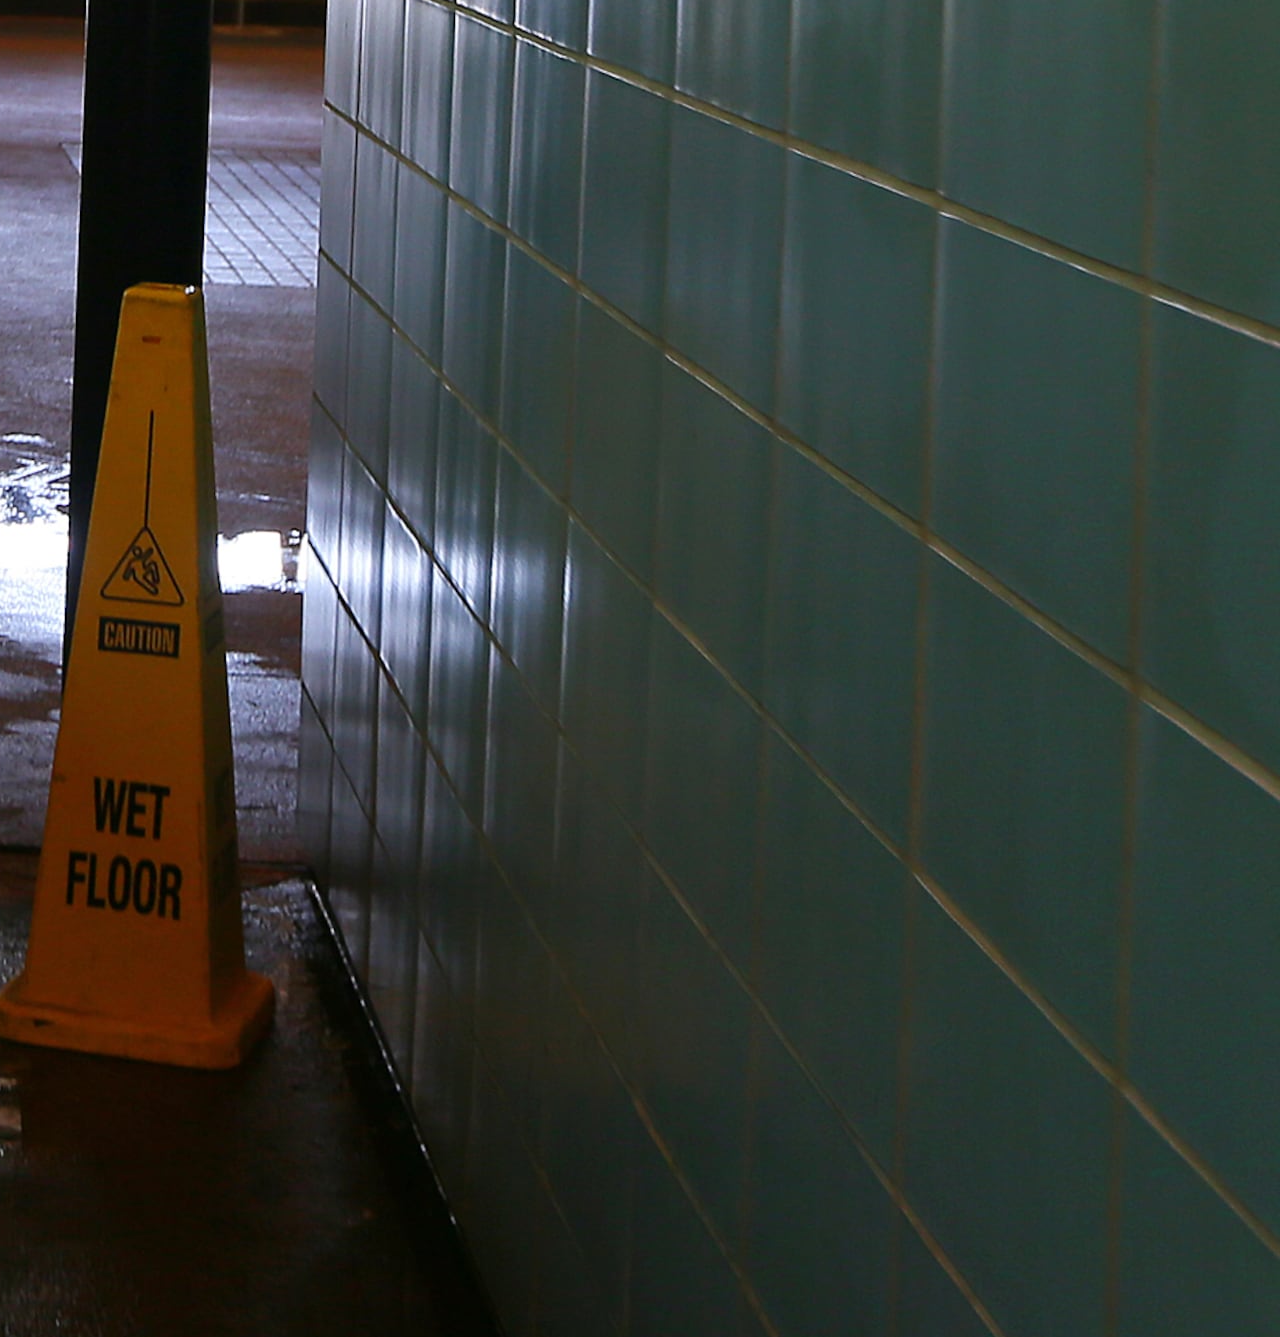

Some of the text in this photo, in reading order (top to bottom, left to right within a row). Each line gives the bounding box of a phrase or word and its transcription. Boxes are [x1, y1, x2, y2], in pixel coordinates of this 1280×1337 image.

[104, 622, 174, 654] CAUTION
[93, 776, 170, 840] WET
[66, 850, 181, 921] FLOOR
